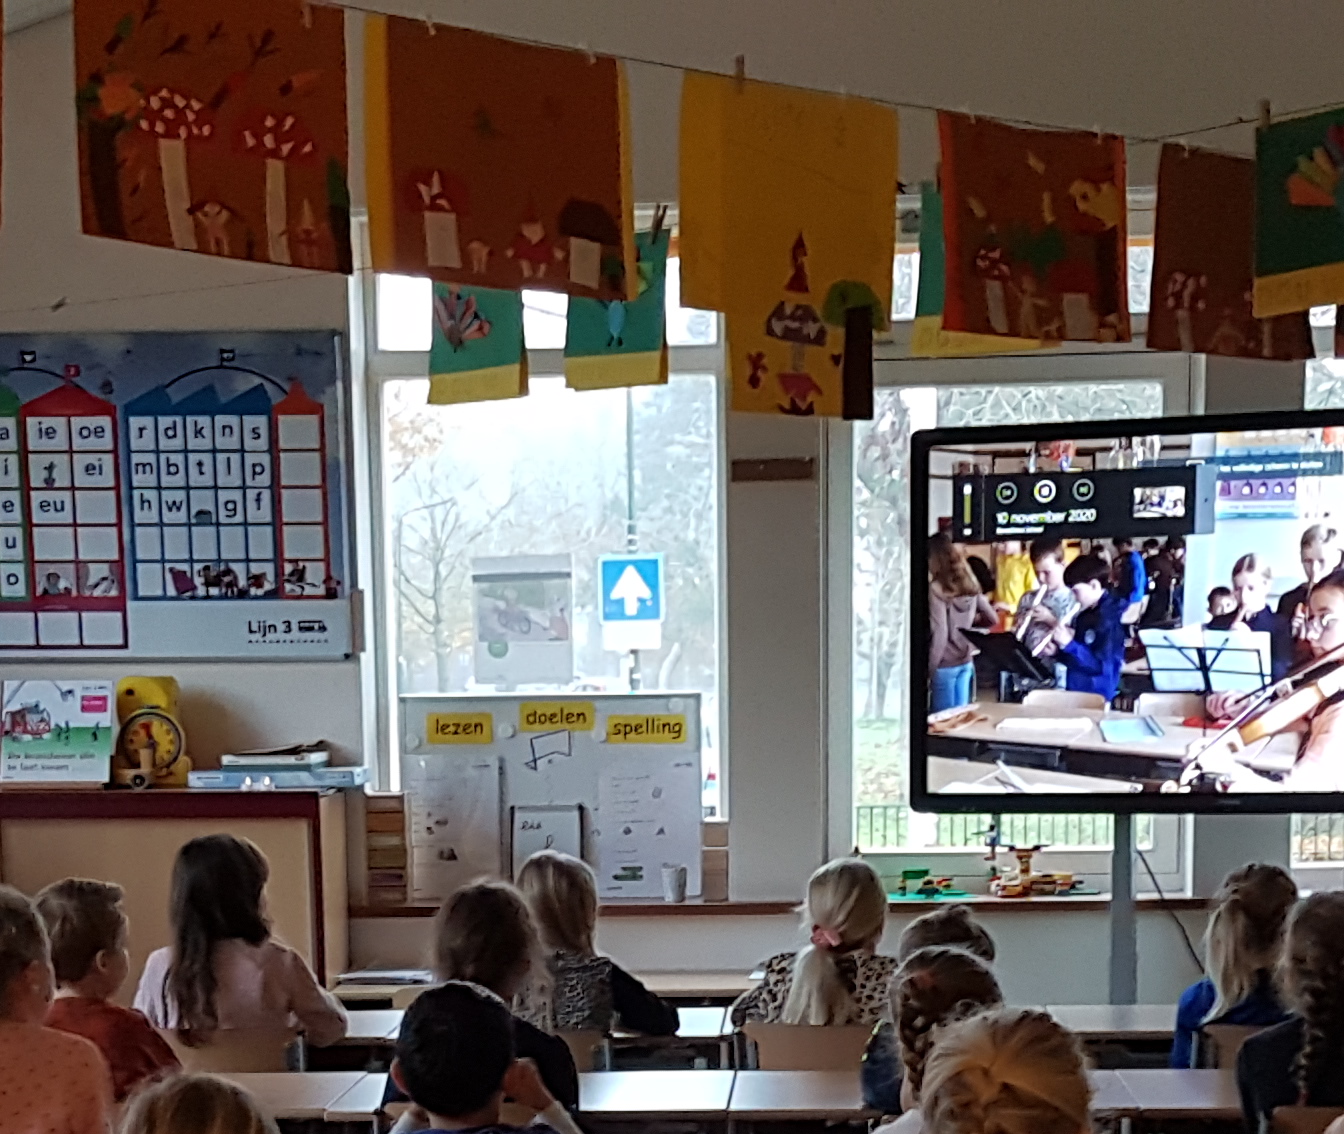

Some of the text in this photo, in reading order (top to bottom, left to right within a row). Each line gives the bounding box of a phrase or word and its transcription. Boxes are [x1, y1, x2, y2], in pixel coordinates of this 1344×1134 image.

[37, 421, 58, 440] ie
[78, 424, 106, 440] oe
[137, 419, 261, 441] r d k n s
[84, 457, 103, 476] ei
[134, 462, 154, 475] m
[166, 456, 180, 476] b
[196, 459, 205, 476] t
[251, 462, 266, 481] p
[1, 499, 15, 513] e
[39, 499, 65, 513] eu
[139, 491, 263, 518] h w g f
[1010, 510, 1067, 524] november
[1068, 508, 1097, 523] 2020
[4, 536, 17, 550] u
[6, 572, 19, 586] o
[248, 620, 292, 638] Lijn 3
[434, 718, 485, 735] lezen
[525, 709, 588, 726] doelen
[611, 717, 684, 739] spelling
